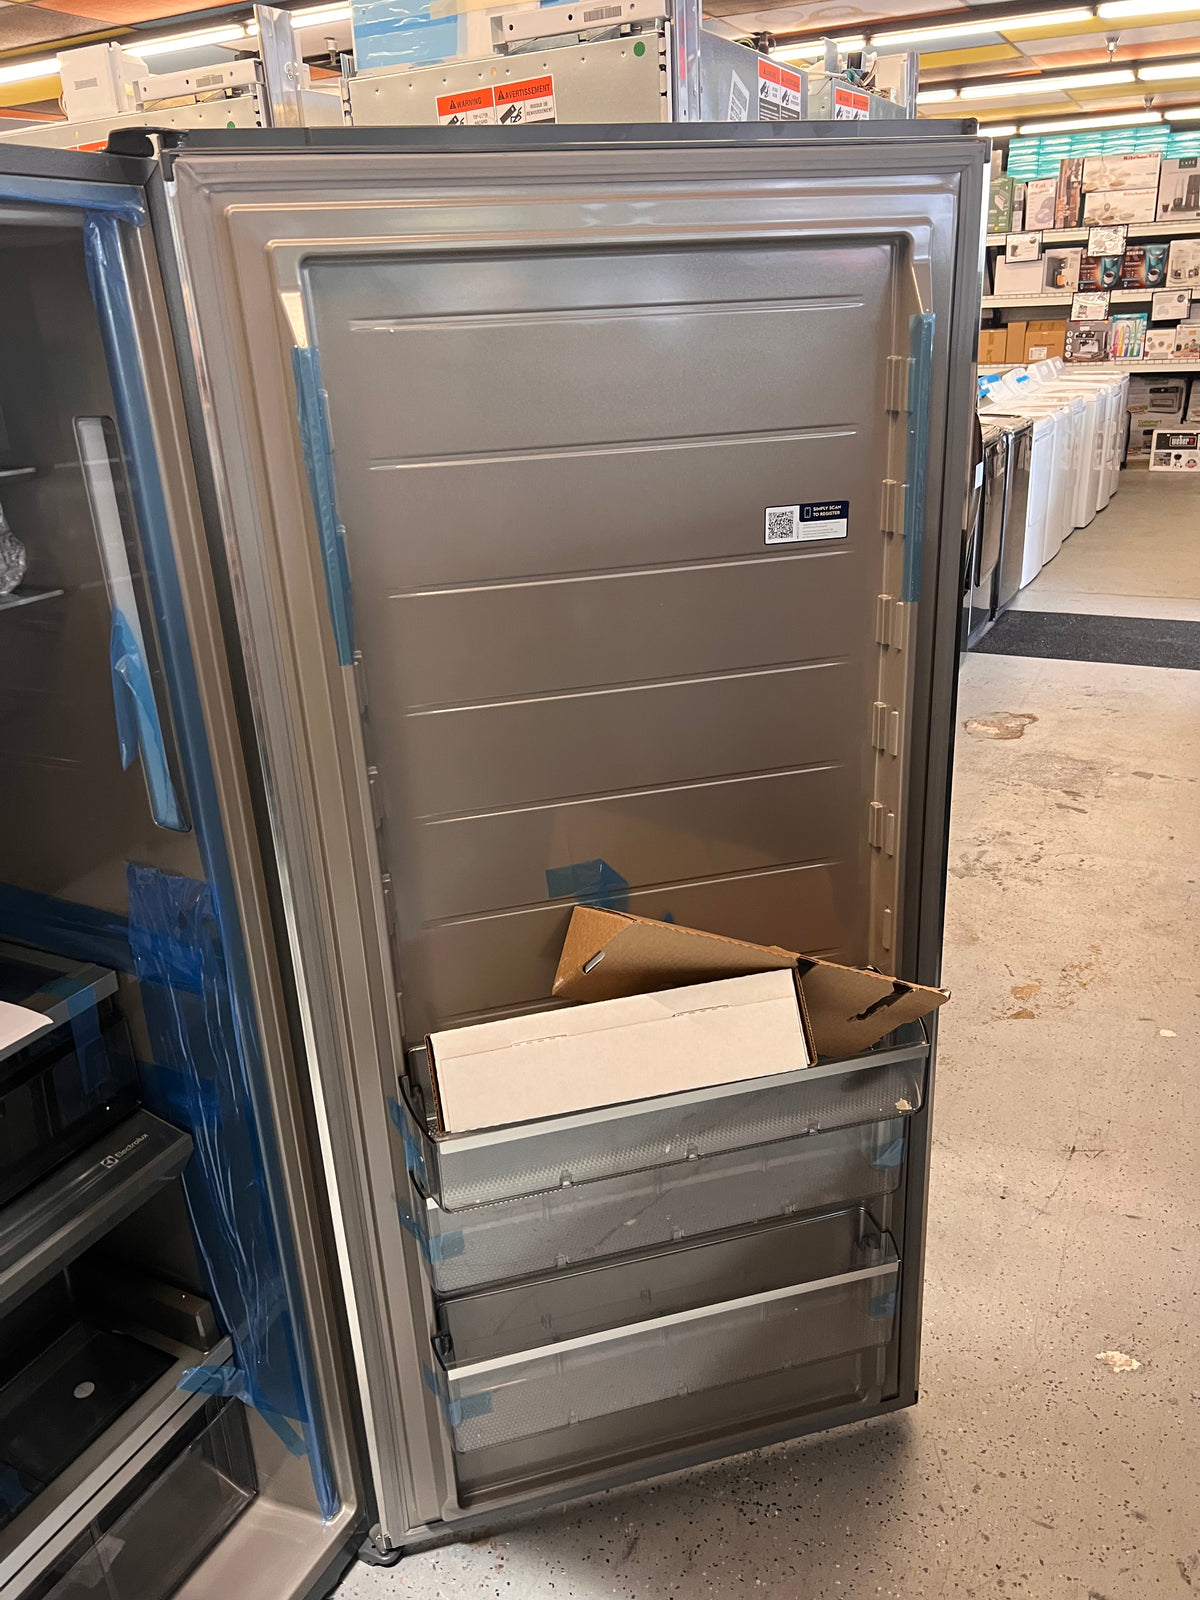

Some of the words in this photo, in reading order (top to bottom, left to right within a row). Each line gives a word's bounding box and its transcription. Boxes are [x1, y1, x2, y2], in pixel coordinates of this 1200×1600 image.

[505, 84, 550, 99] AVERTISSEMENT
[457, 97, 482, 109] WARNING
[1171, 436, 1189, 445] weber
[114, 1133, 149, 1158] Electrolux
